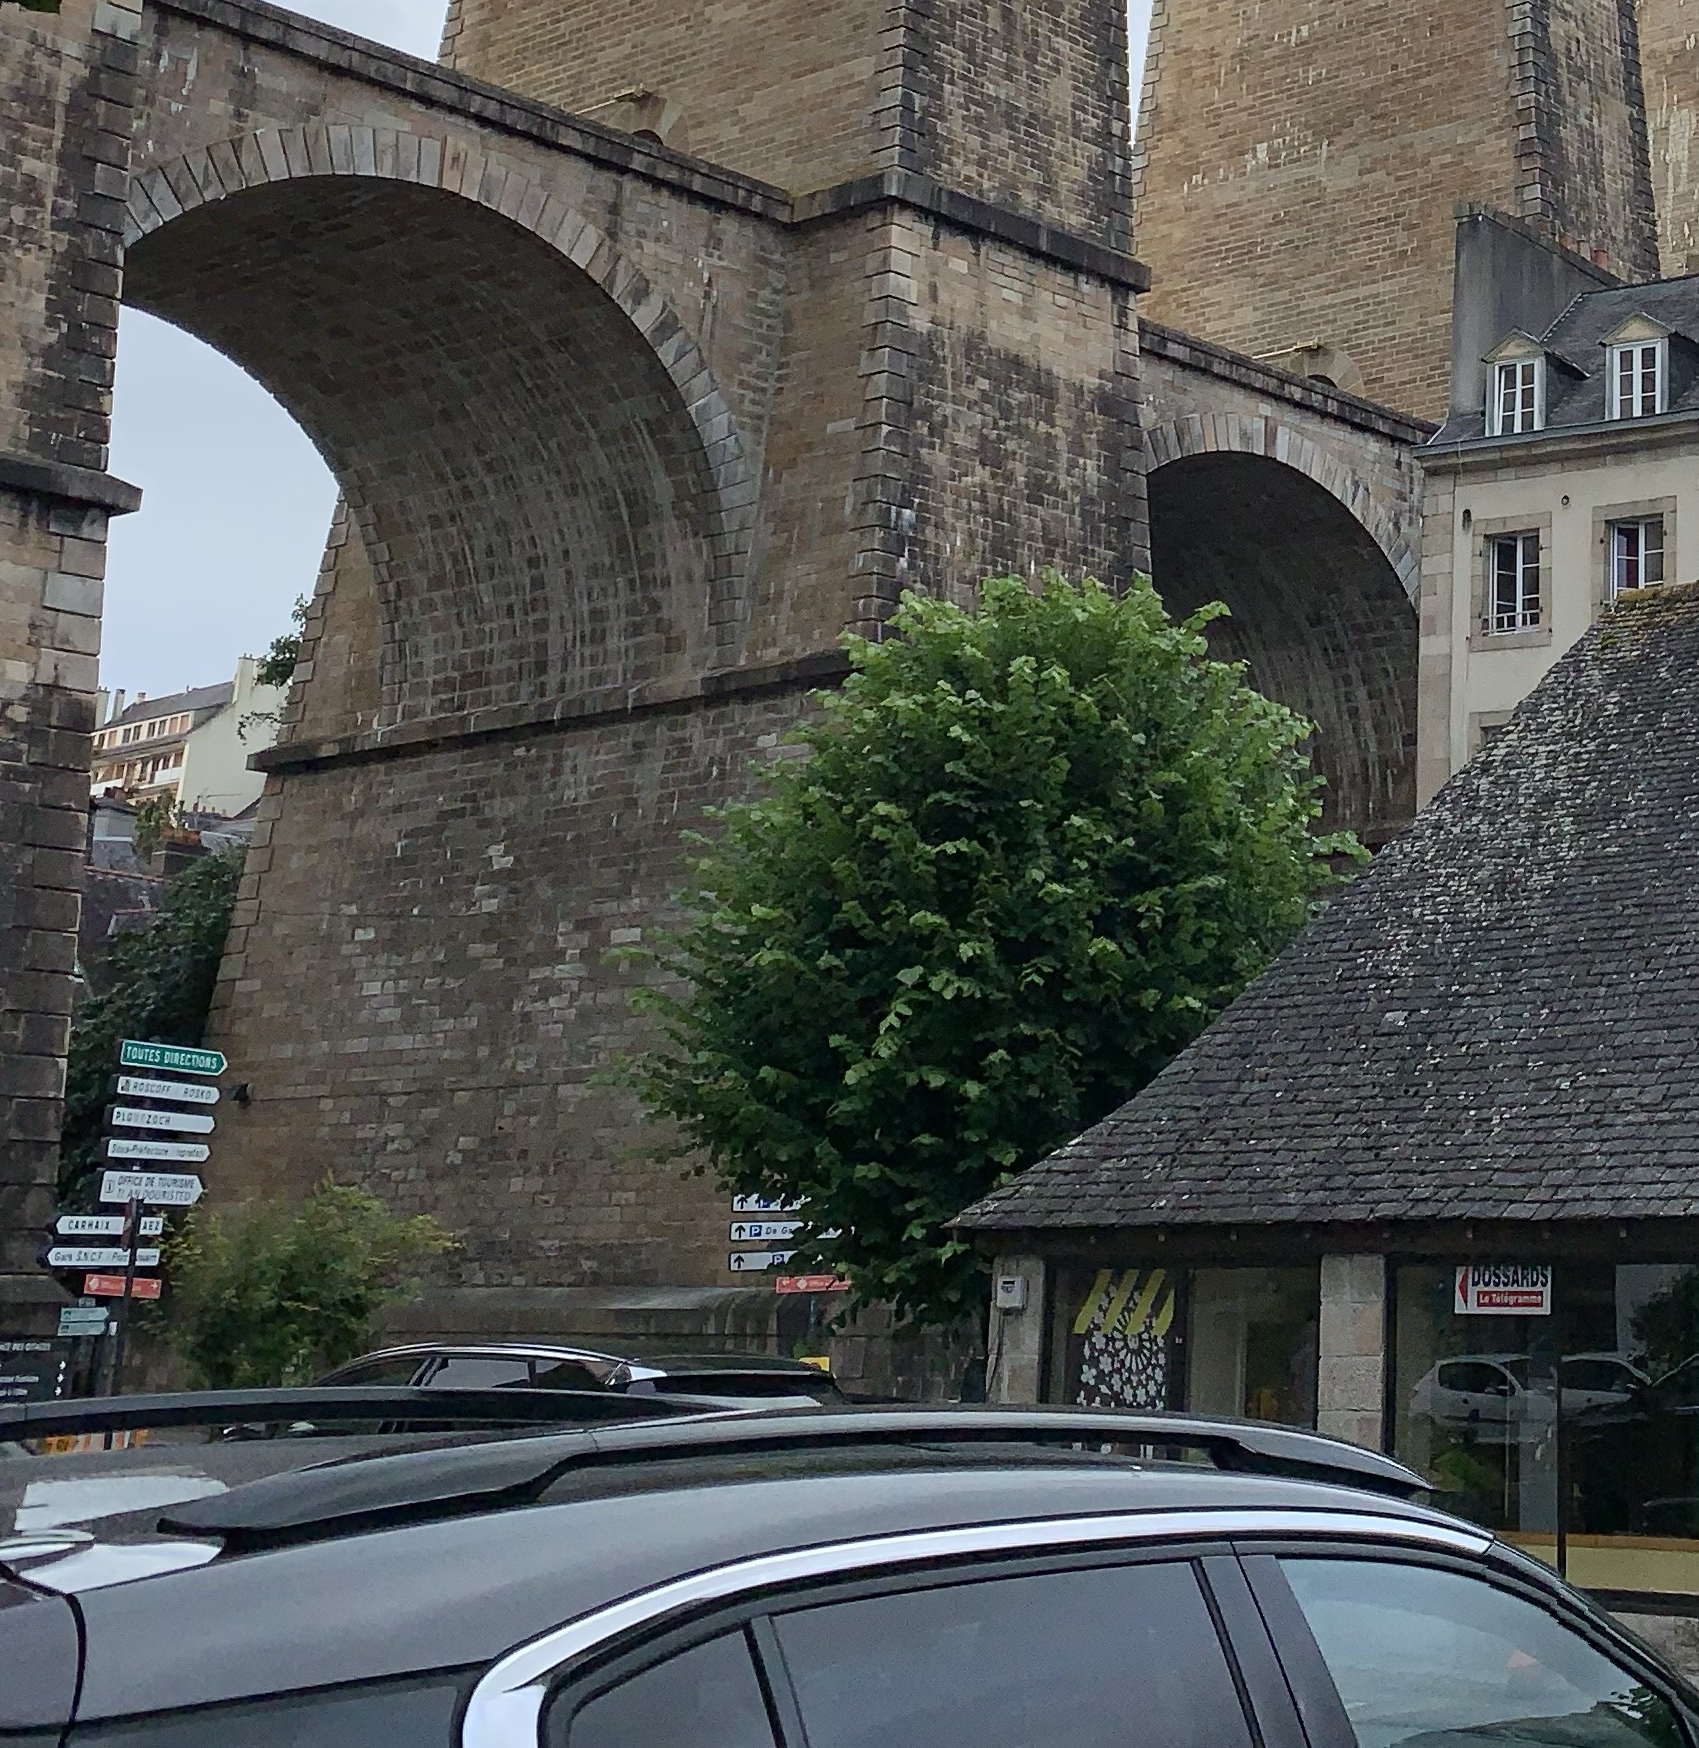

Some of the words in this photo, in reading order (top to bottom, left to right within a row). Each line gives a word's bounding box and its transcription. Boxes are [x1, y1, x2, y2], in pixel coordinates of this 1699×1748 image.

[126, 1045, 160, 1062] TOUTES
[163, 1050, 218, 1069] DIRECTIONS
[133, 1081, 171, 1095] ROSCOFF
[183, 1087, 211, 1100] ROSKO
[117, 1175, 143, 1187] OFFICE
[145, 1176, 155, 1187] DE
[159, 1177, 195, 1189] TOURISME
[68, 1220, 110, 1231] CARHAIX
[54, 1252, 73, 1262] Gare
[1471, 1266, 1549, 1288] DOSSARDS
[1480, 1294, 1490, 1304] Le
[1491, 1292, 1542, 1305] Télégramme
